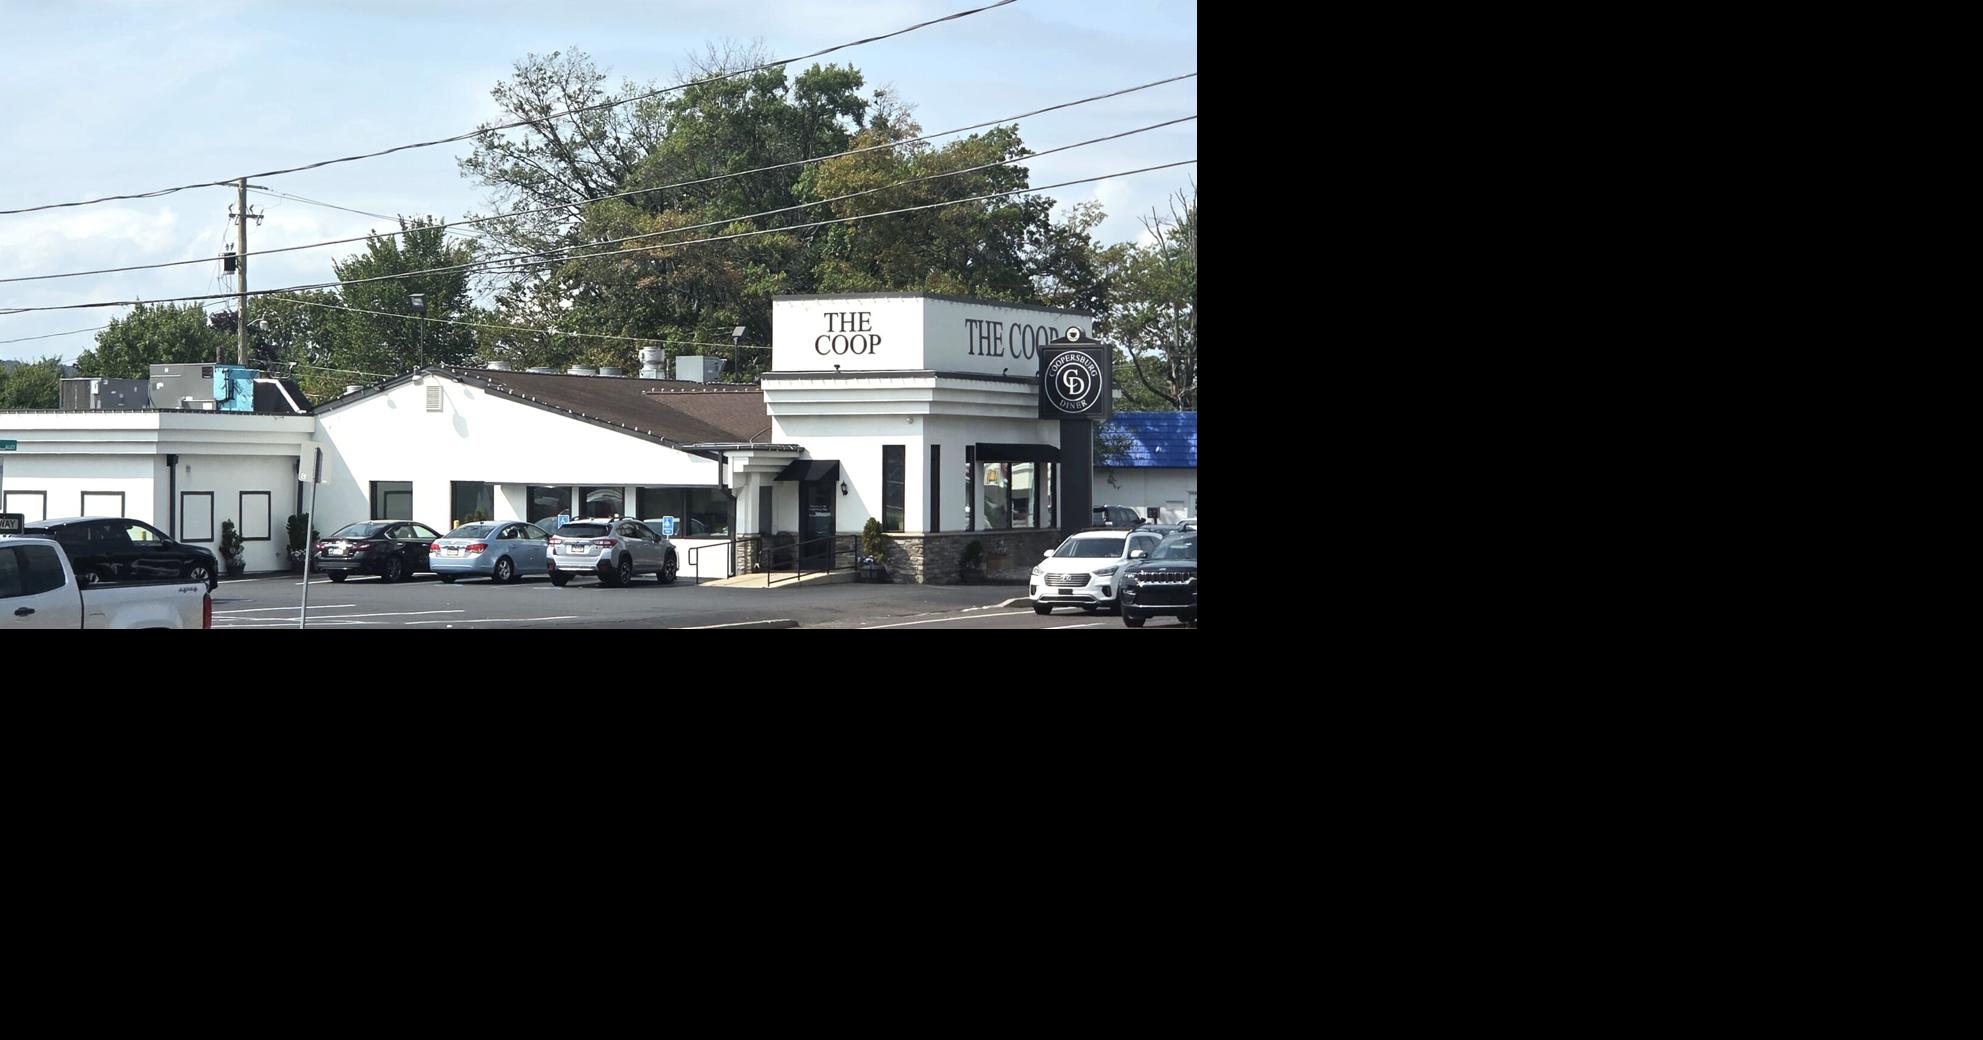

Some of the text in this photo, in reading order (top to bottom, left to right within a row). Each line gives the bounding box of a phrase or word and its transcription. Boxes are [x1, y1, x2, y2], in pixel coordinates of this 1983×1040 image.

[823, 311, 872, 333] THE
[814, 333, 882, 356] COOP
[965, 318, 1005, 357] THE
[1049, 354, 1098, 377] COOPERSBURG
[1059, 399, 1088, 409] DINER
